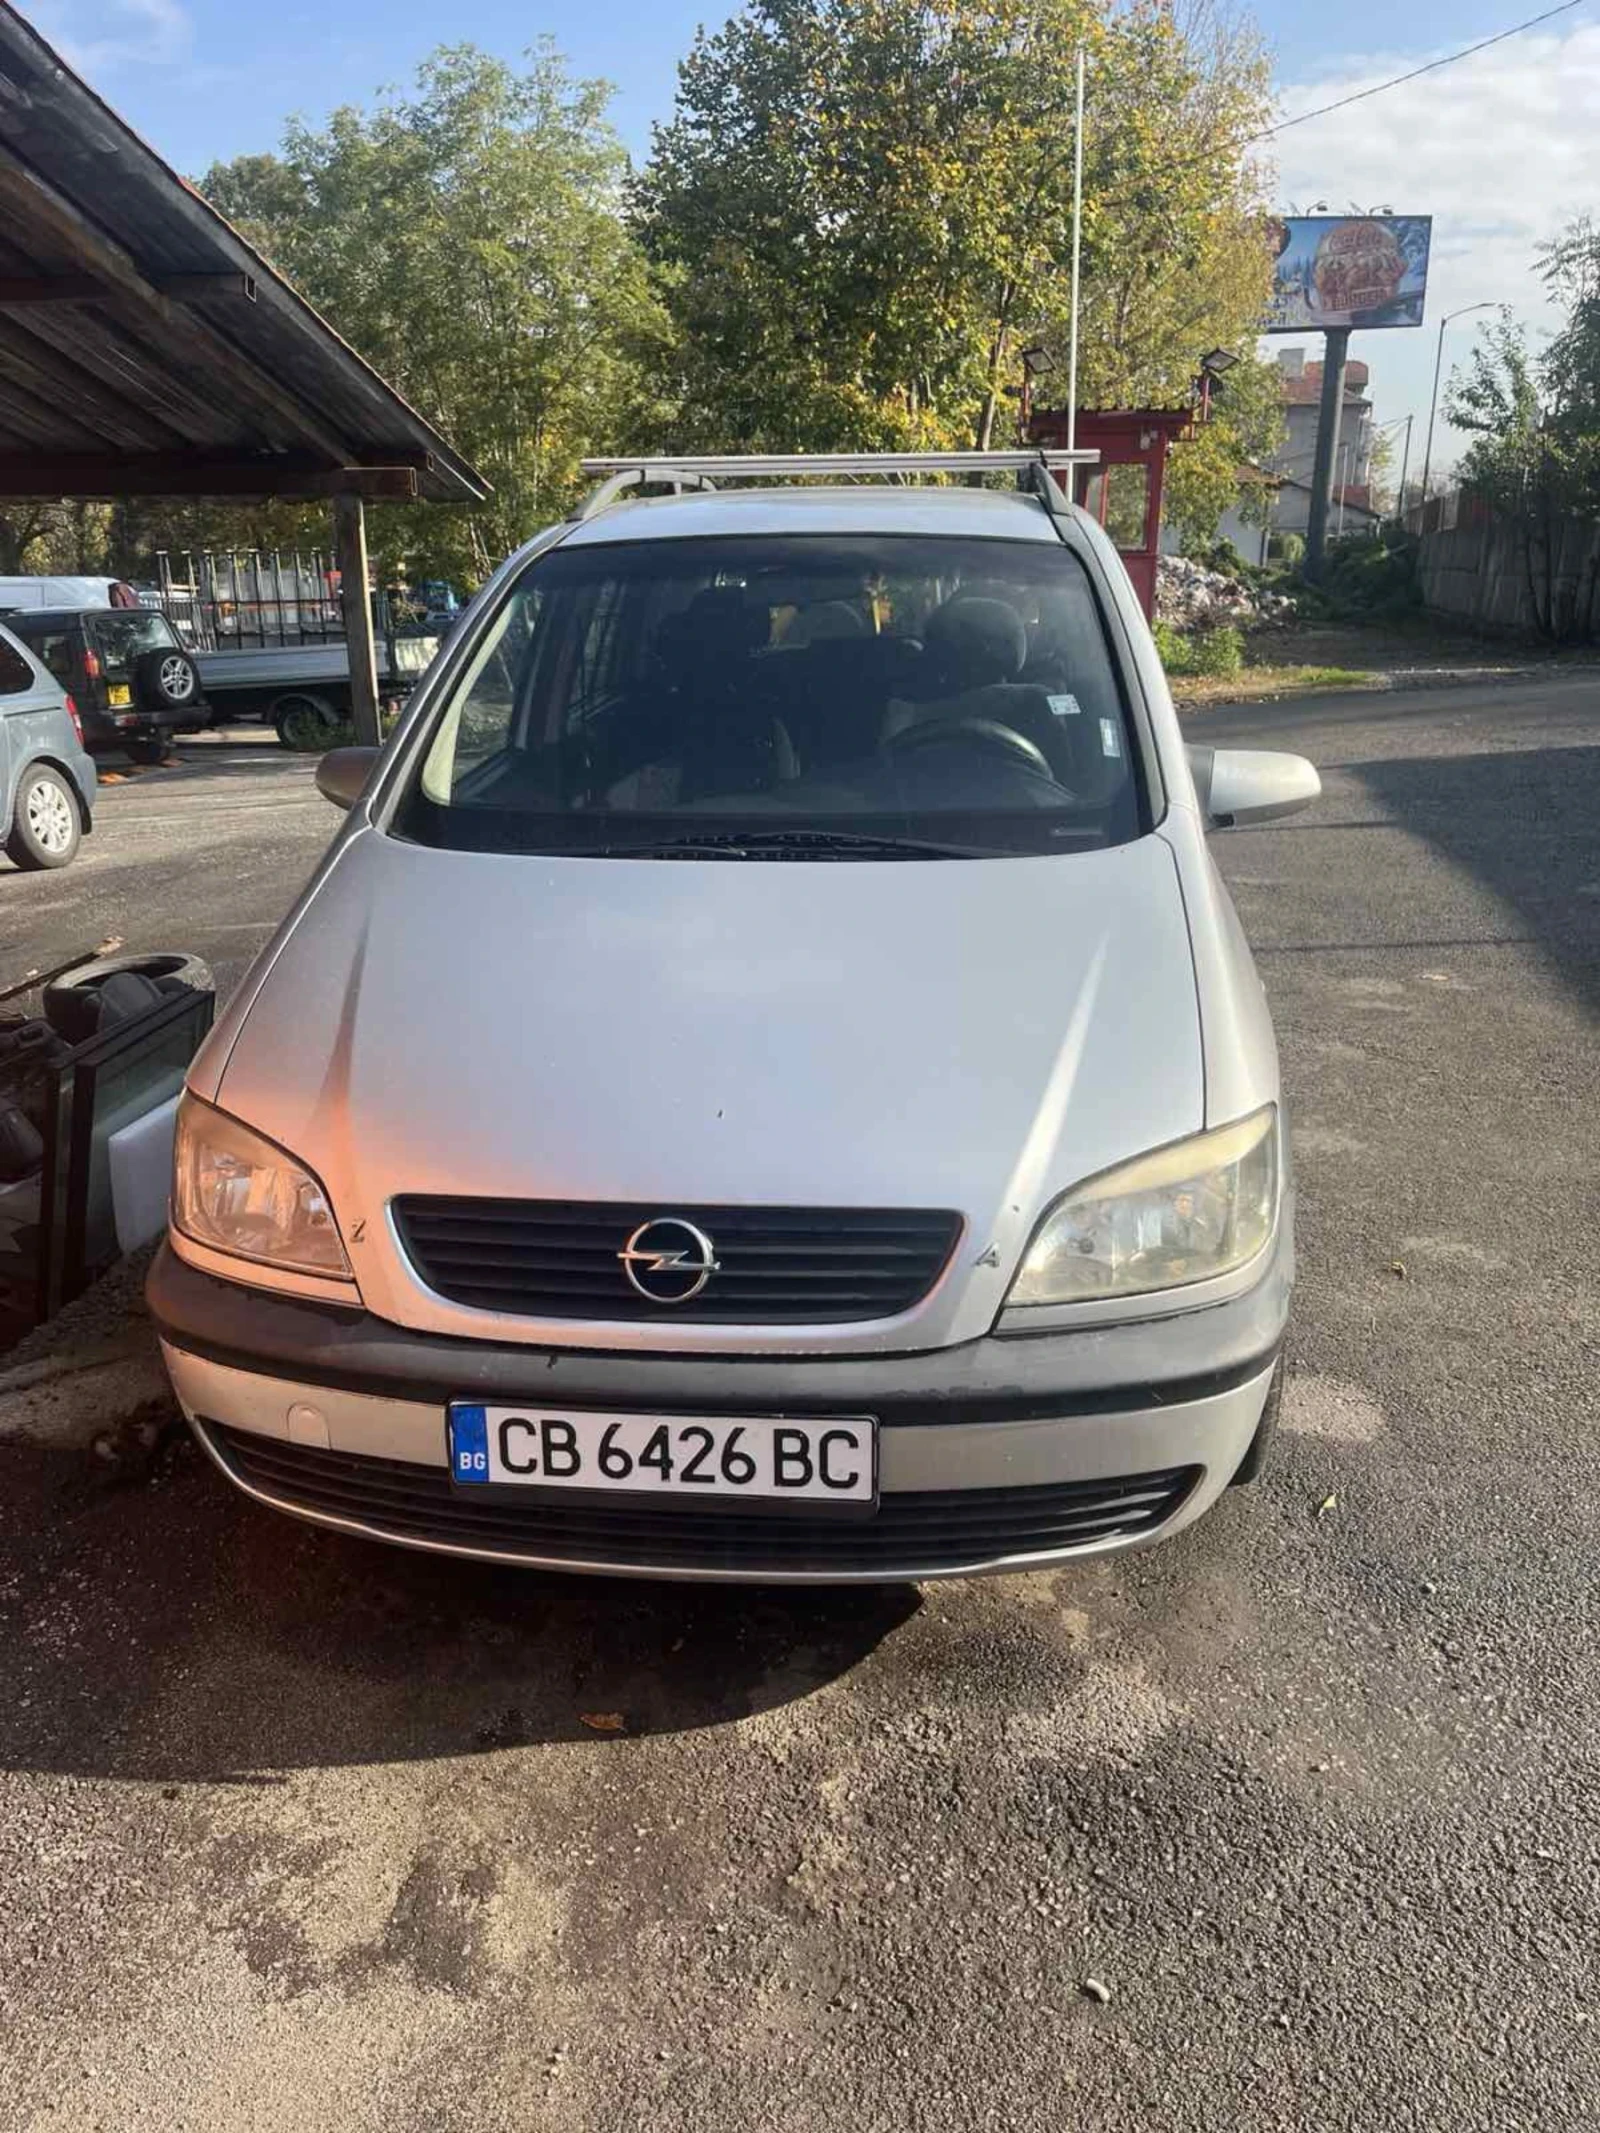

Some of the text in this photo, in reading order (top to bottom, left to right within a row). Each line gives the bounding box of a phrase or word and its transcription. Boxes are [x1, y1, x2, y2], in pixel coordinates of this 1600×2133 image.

[459, 1452, 486, 1471] BG
[498, 1417, 860, 1490] CB 6426 BC
